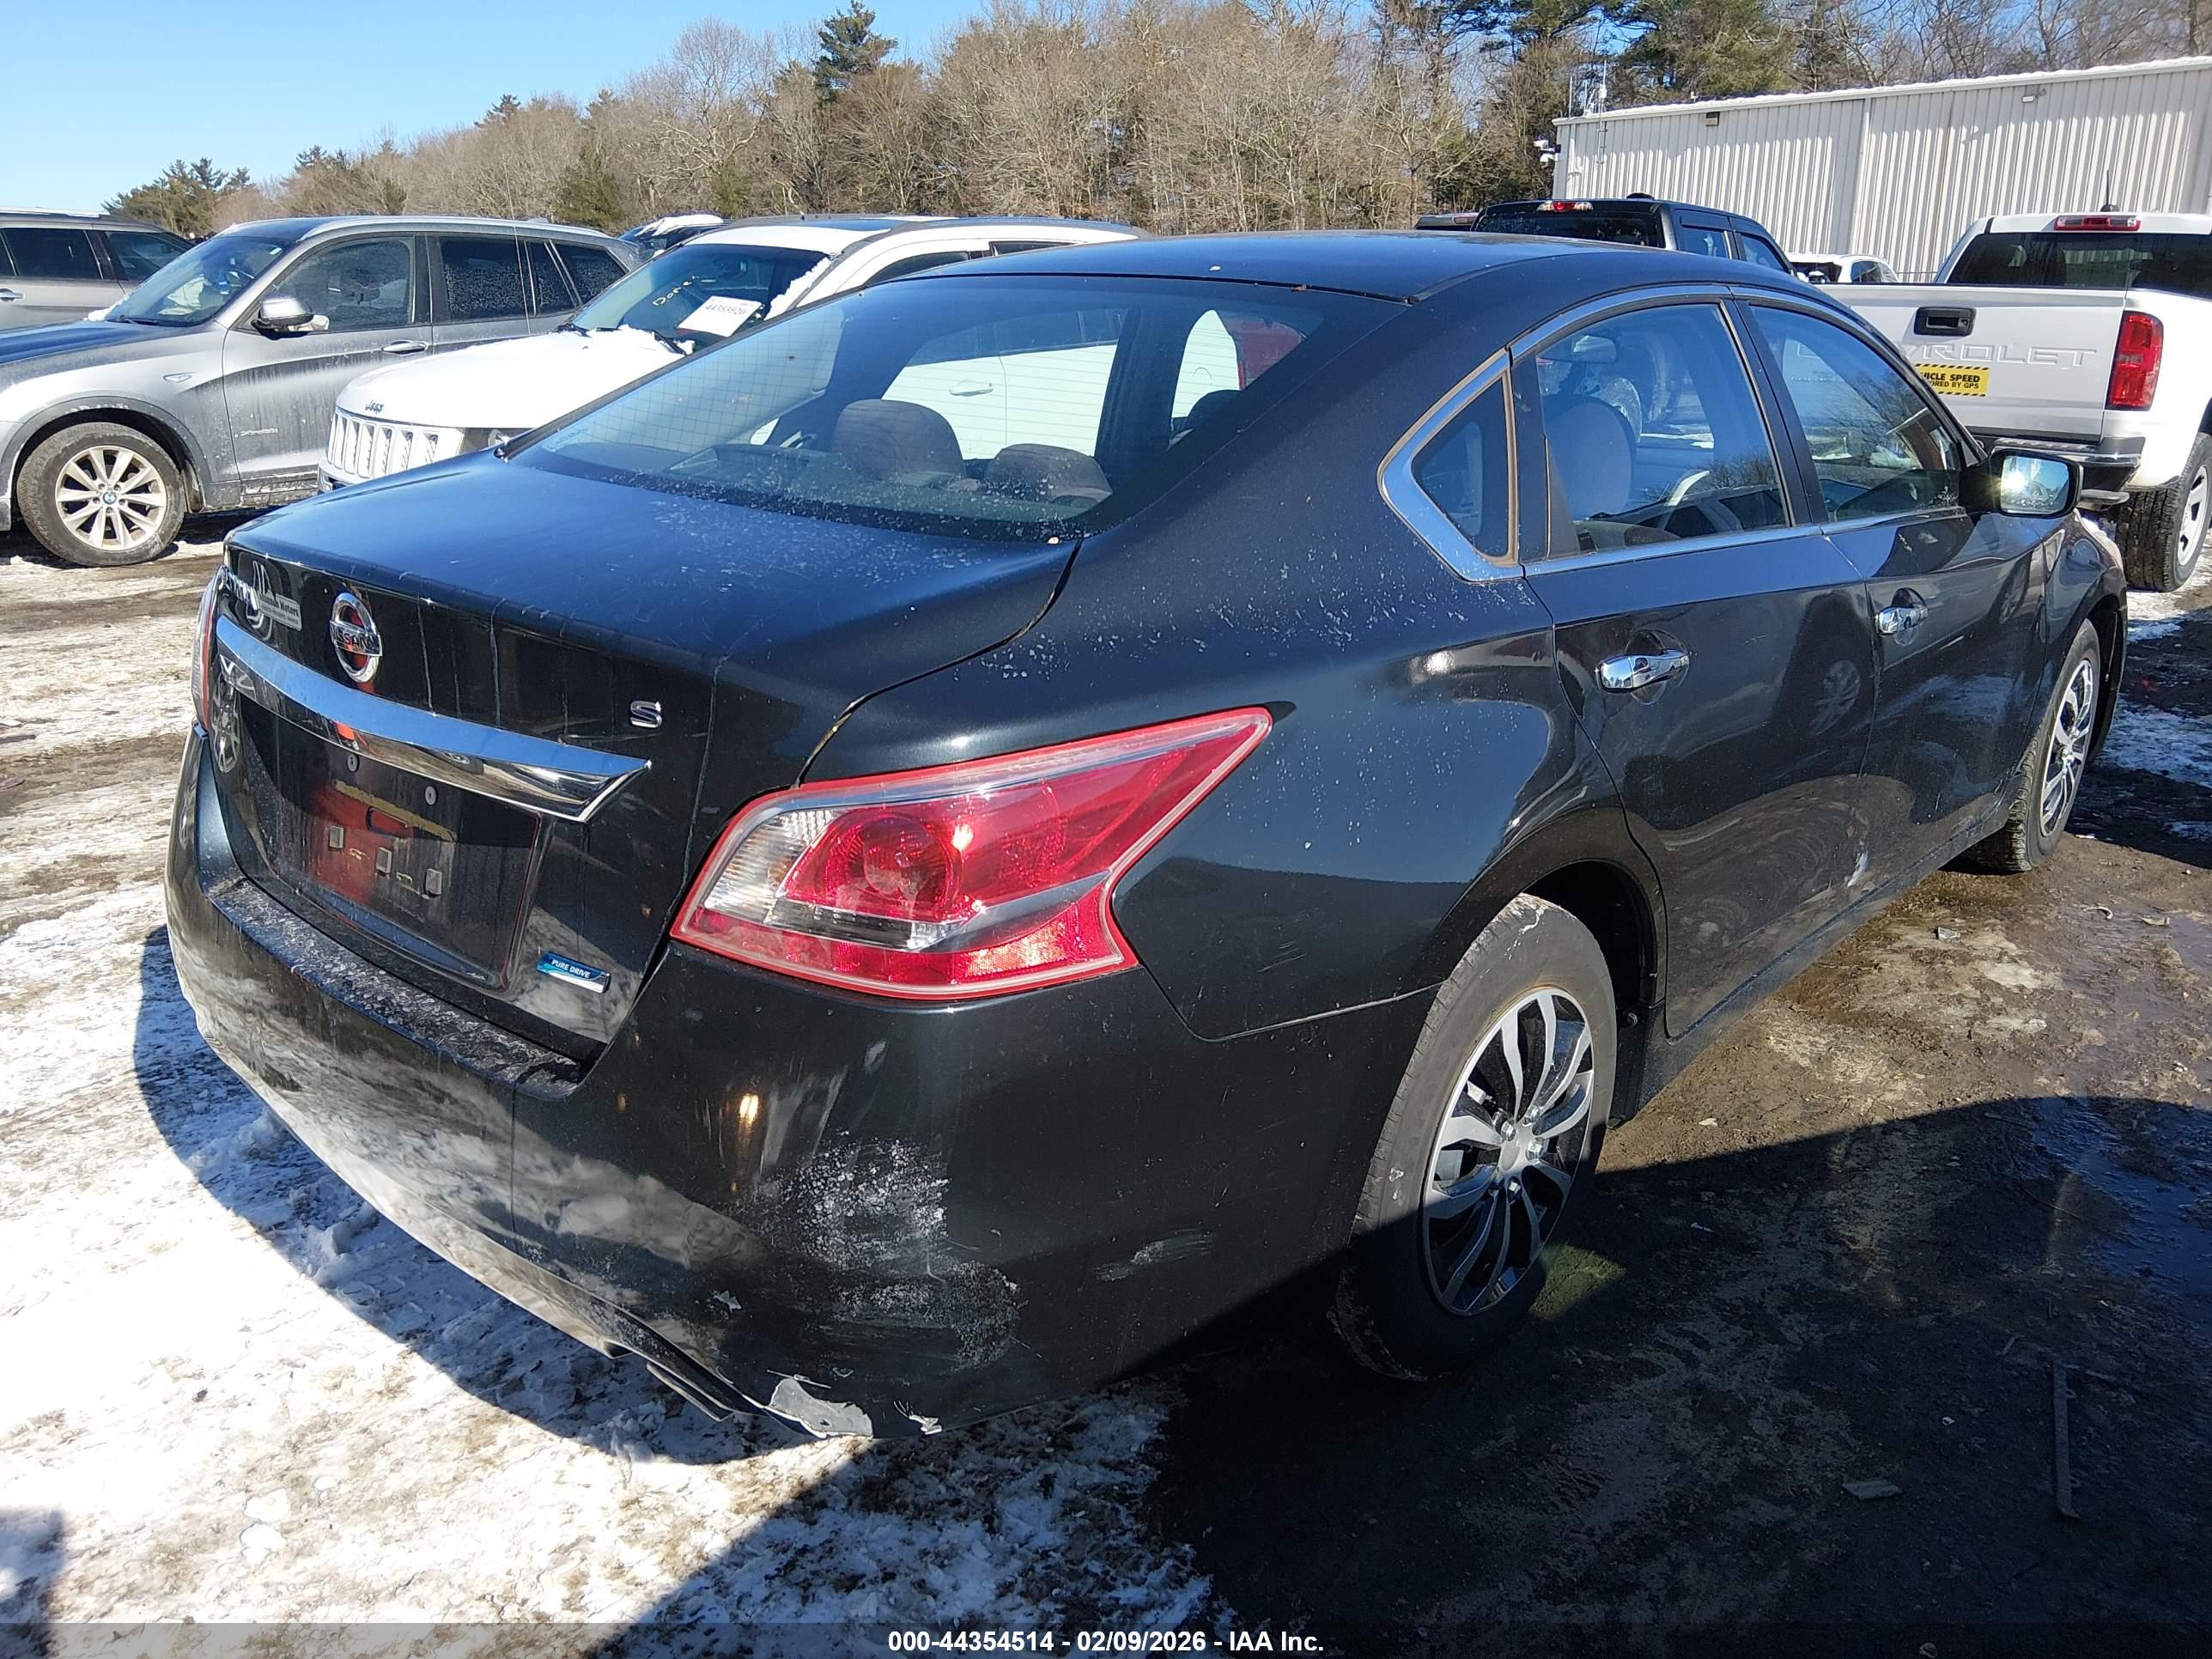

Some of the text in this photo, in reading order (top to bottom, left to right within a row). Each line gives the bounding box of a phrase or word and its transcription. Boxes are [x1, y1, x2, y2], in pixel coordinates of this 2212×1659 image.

[1950, 374, 1980, 383] SPEED
[630, 701, 662, 728] S
[551, 959, 591, 979] PURE DRIVE
